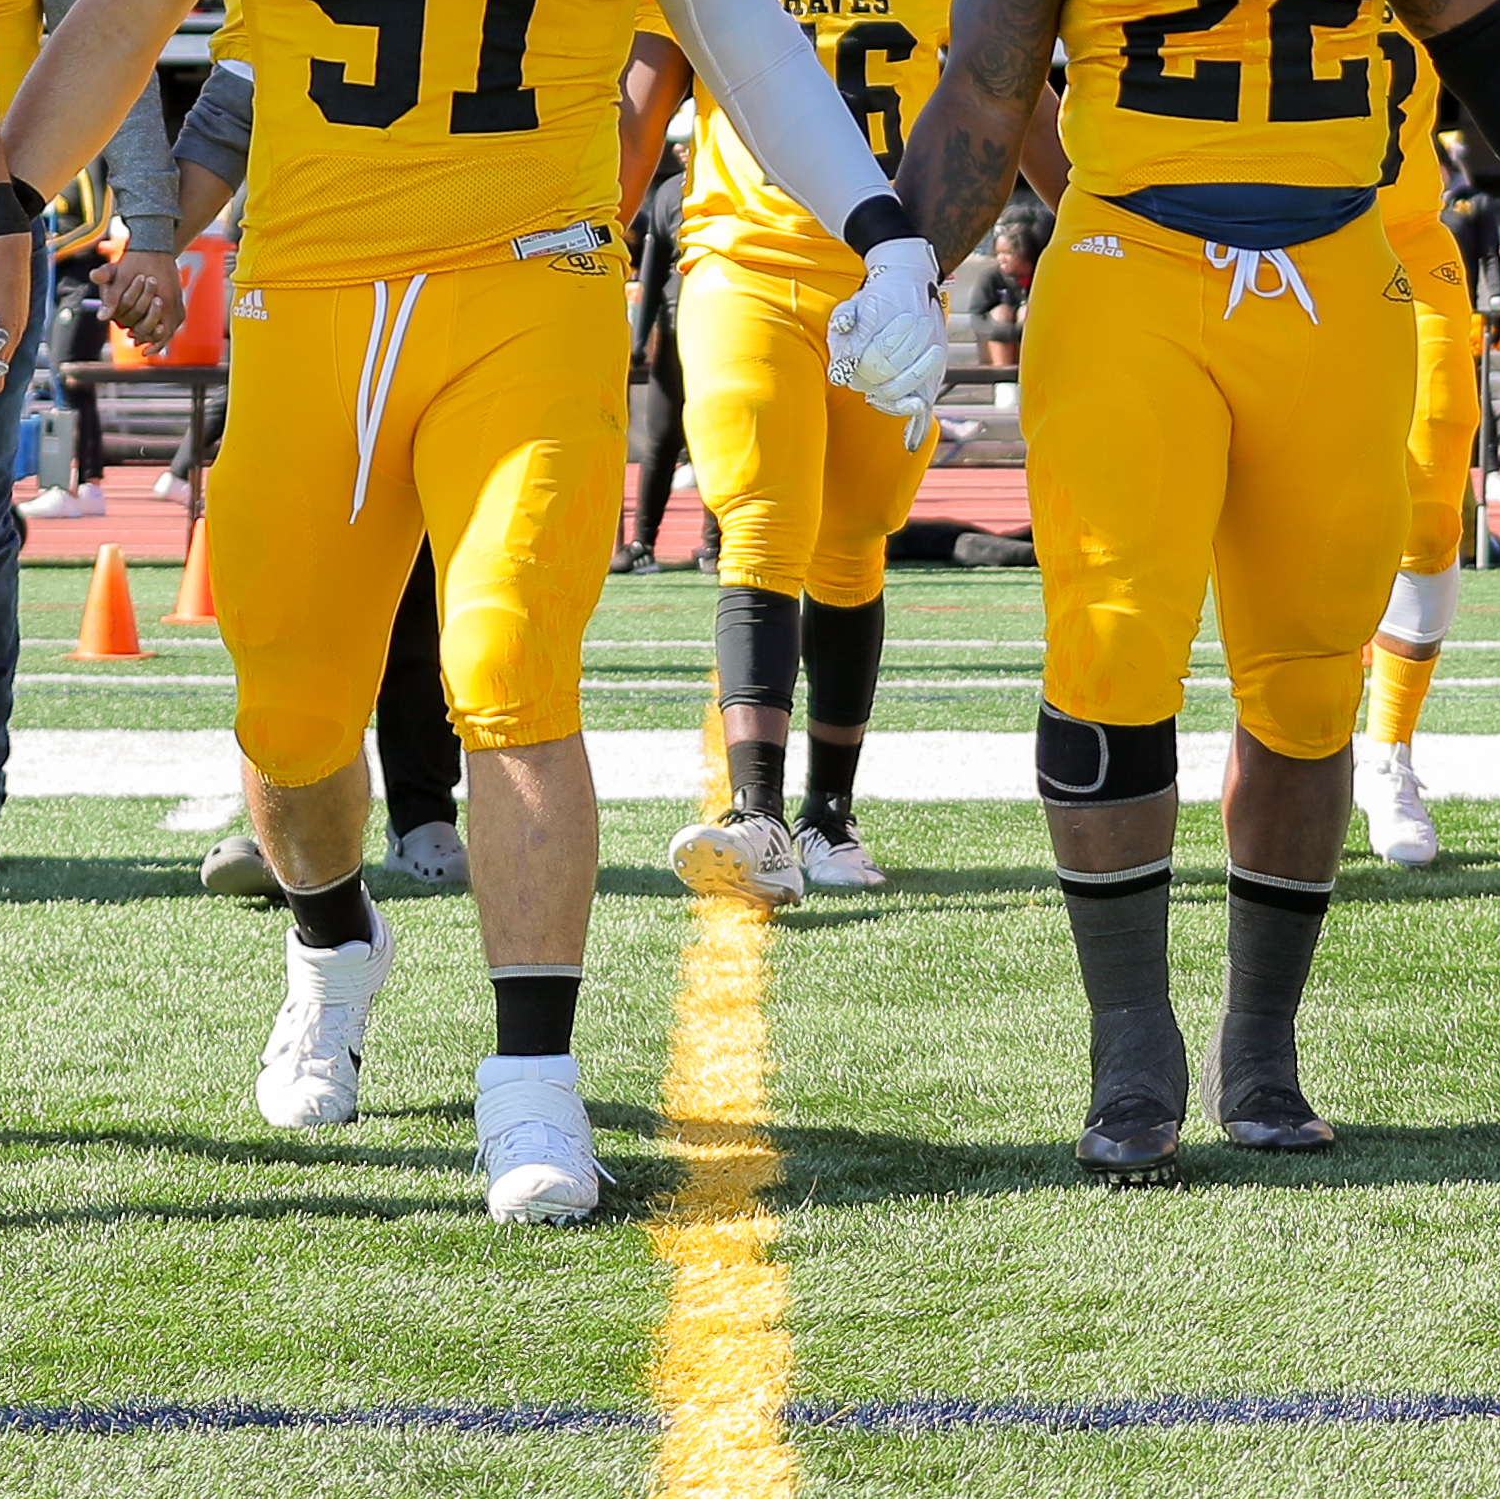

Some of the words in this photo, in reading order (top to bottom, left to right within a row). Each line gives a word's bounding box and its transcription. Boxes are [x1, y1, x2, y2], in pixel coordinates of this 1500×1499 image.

[800, 21, 920, 182] 6
[1070, 239, 1125, 258] adidas
[232, 304, 269, 321] adidas
